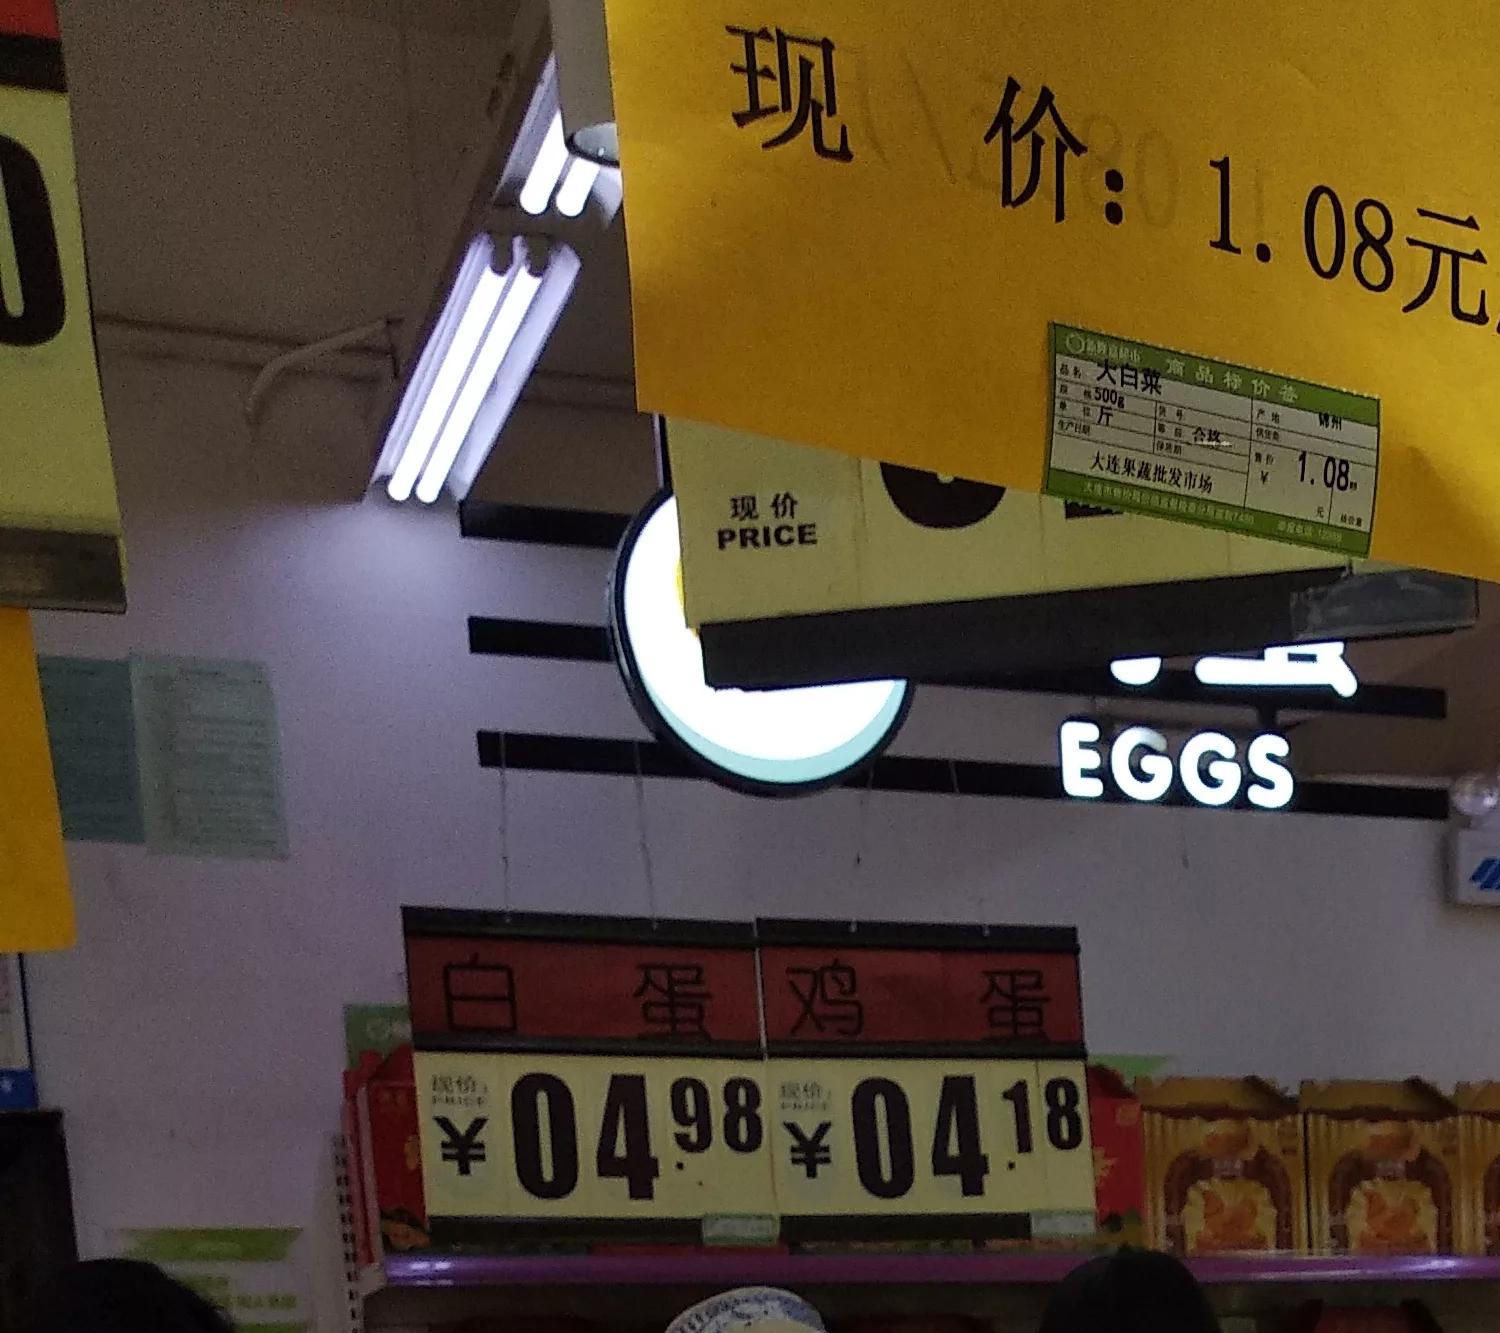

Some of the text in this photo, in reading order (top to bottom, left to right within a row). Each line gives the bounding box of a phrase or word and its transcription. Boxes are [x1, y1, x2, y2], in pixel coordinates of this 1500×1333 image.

[1096, 360, 1162, 396] 大白菜
[1090, 450, 1214, 495] 大连果蔬批发市场
[729, 491, 800, 521] 现价
[716, 522, 818, 551] PRICE
[1058, 722, 1296, 806] EGGS
